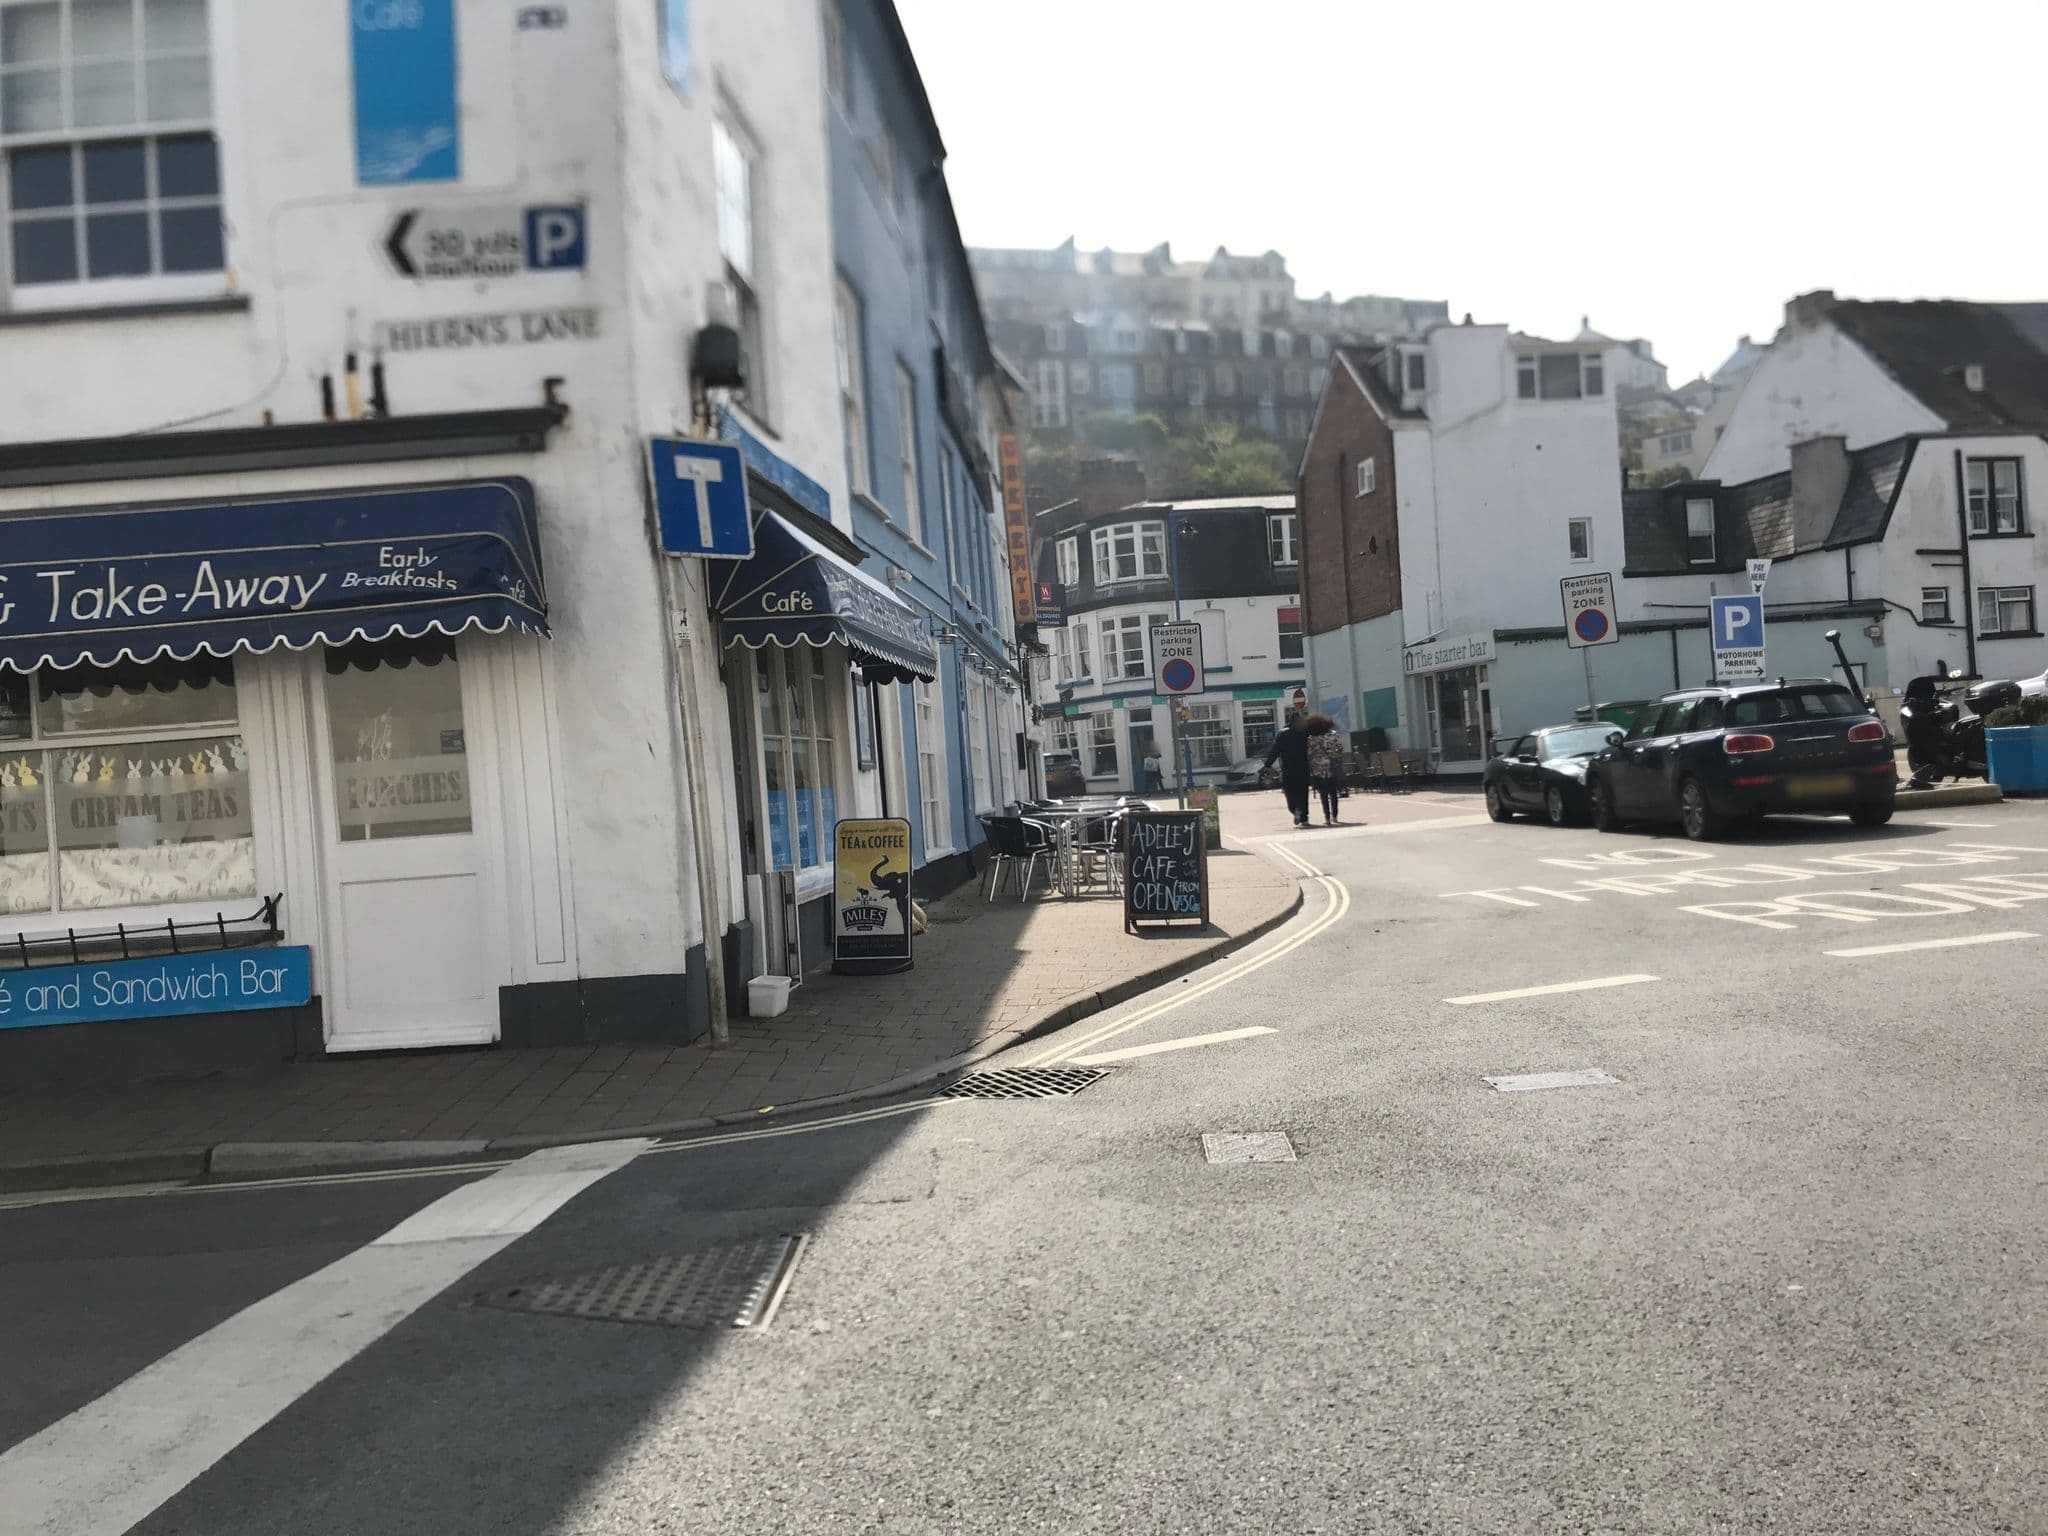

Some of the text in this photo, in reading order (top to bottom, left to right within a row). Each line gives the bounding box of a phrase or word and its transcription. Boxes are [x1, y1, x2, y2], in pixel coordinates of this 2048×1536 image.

[536, 213, 577, 269] P
[520, 306, 601, 342] LANE
[379, 546, 439, 567] Early
[340, 568, 458, 590] Breakfasts
[1564, 576, 1609, 589] Restricted
[36, 560, 326, 624] Take-Away
[761, 590, 814, 613] Café
[1571, 587, 1604, 597] parking
[1573, 596, 1605, 609] ZONE
[1153, 626, 1198, 637] Restricted
[1724, 605, 1751, 641] P
[1160, 637, 1192, 646] parking
[1161, 647, 1193, 658] ZONE
[1415, 638, 1487, 668] The starter bar
[1717, 650, 1764, 660] MOTORHOME
[1724, 659, 1757, 668] PARKING
[171, 787, 239, 821] TEAS
[840, 836, 860, 850] TEA
[868, 835, 905, 849] COFFEE
[1132, 854, 1178, 882] CAFE
[1537, 847, 1716, 871] NO
[1438, 842, 2048, 907] THROUGH
[1133, 880, 1179, 911] OPEN
[846, 908, 886, 923] MILES
[25, 969, 80, 1012] and
[93, 959, 229, 1008] Sandwich
[240, 959, 289, 996] Bar
